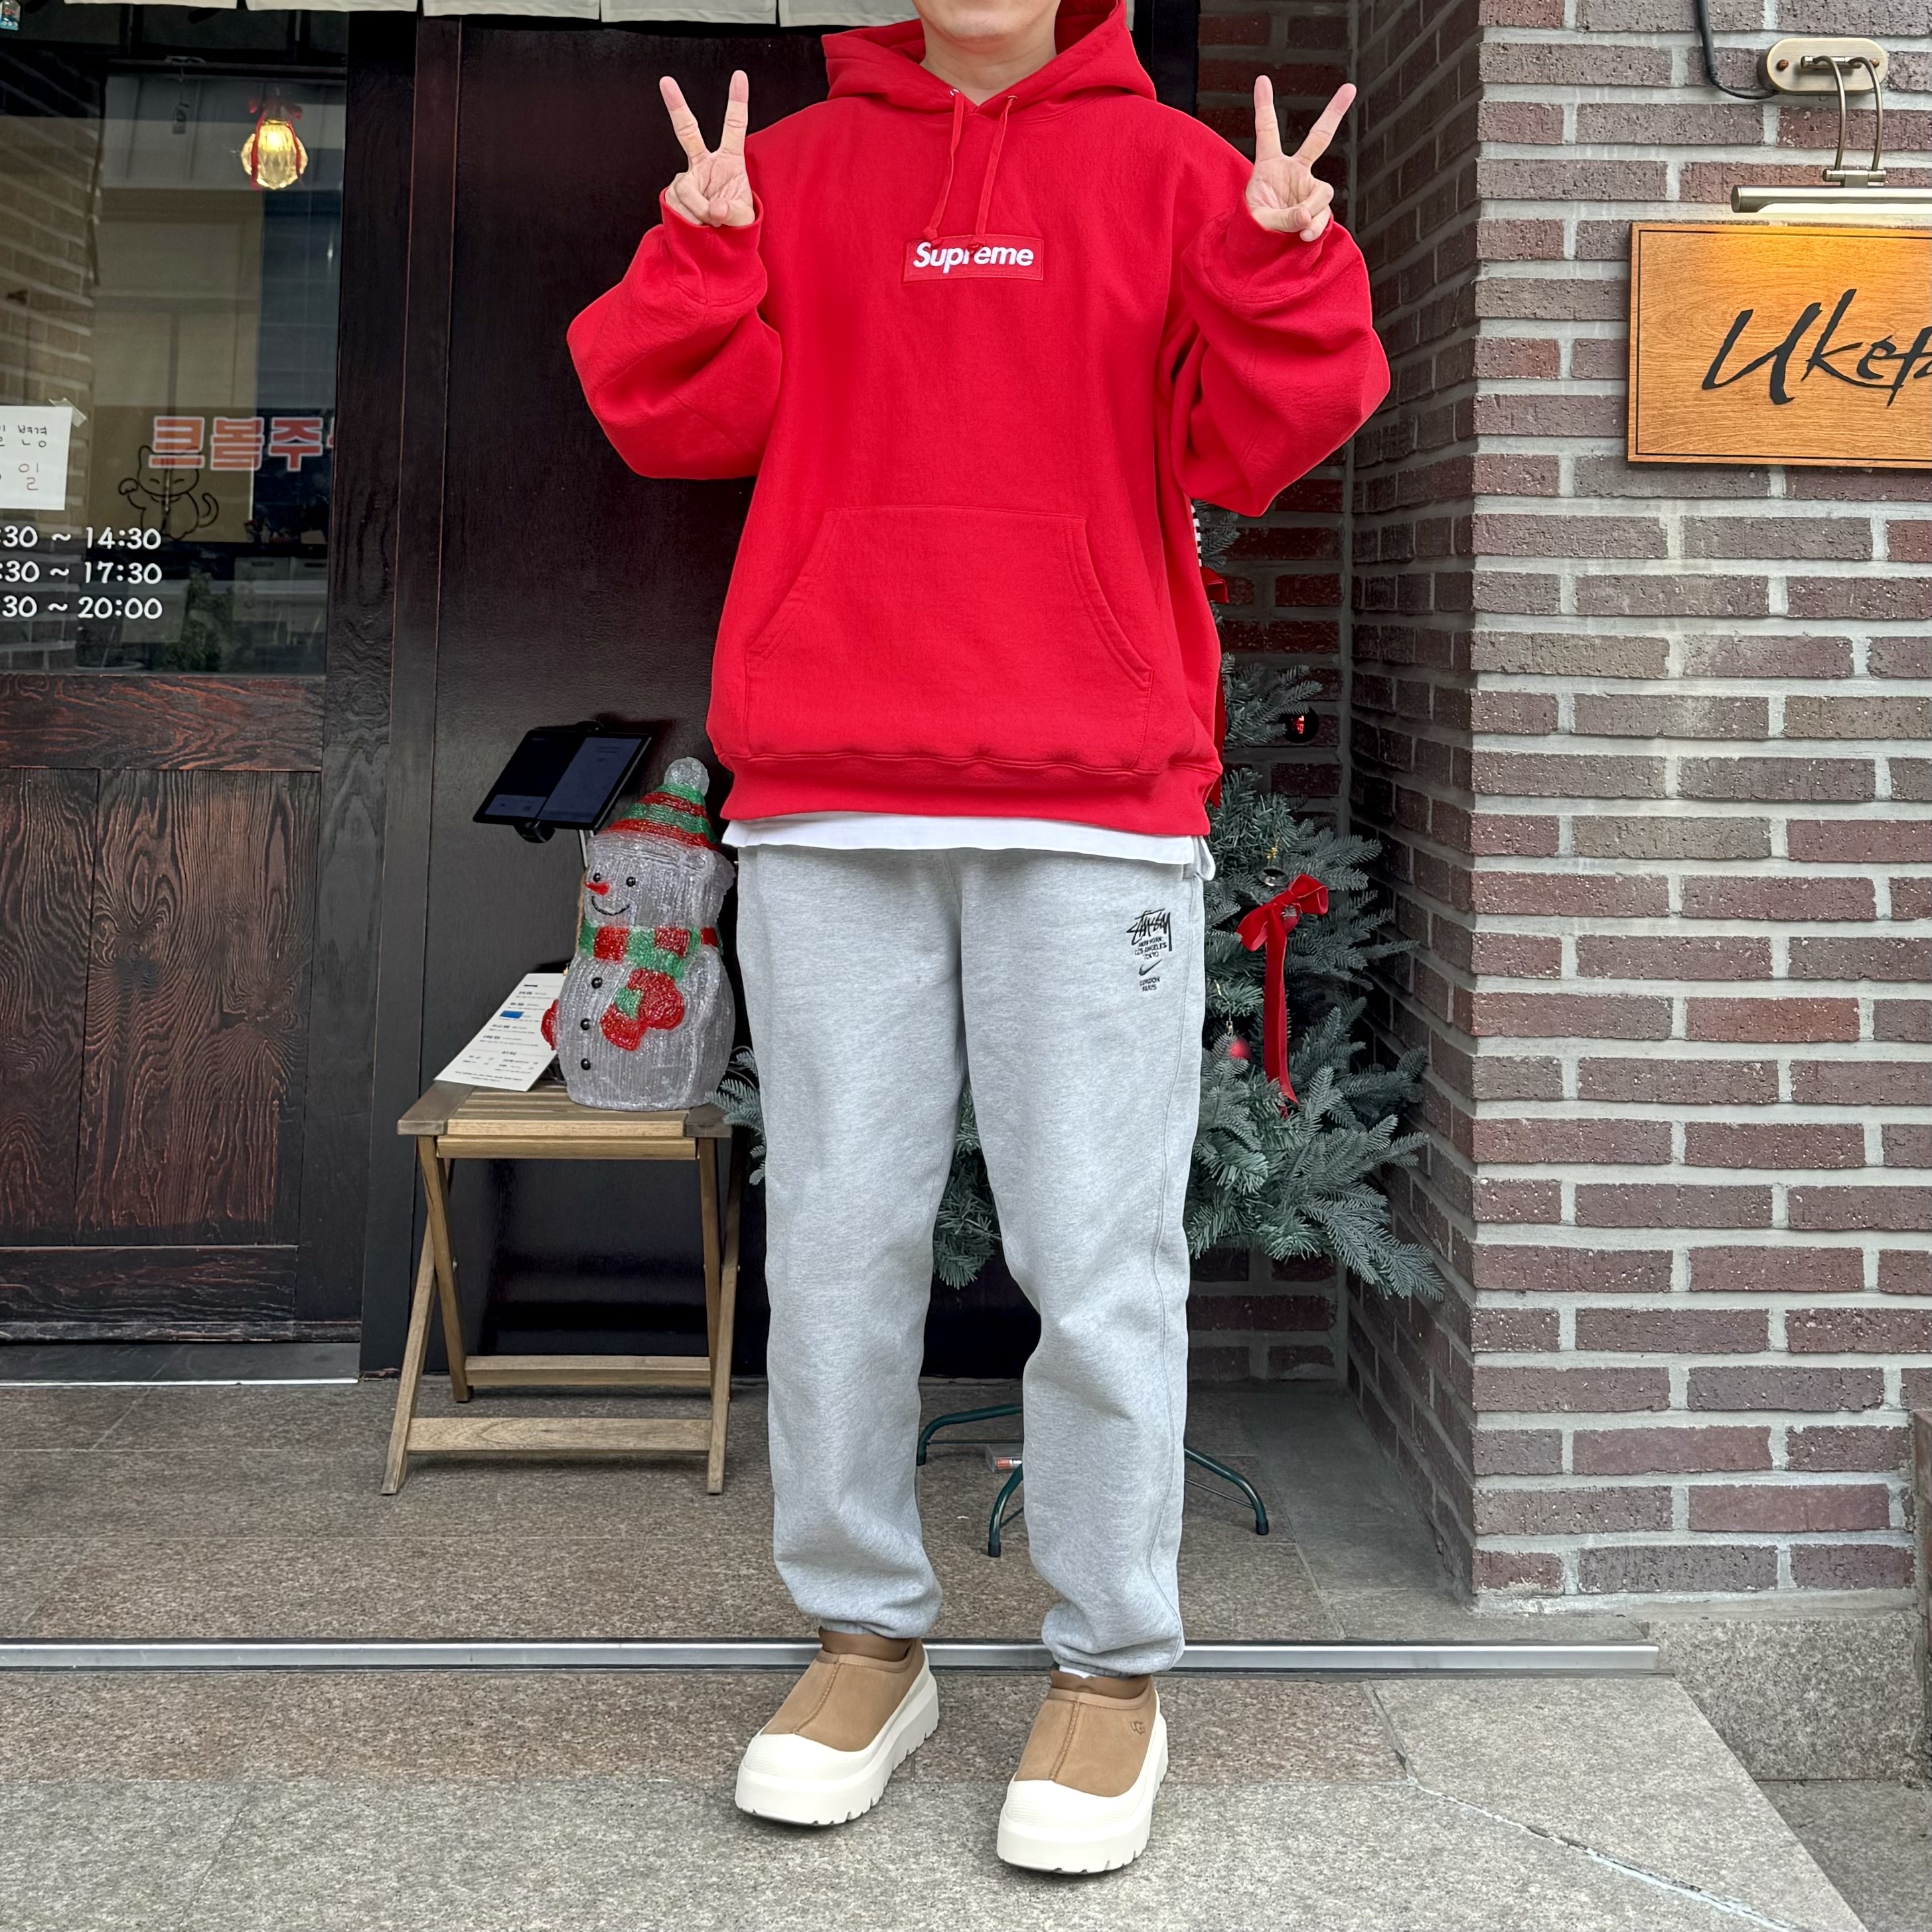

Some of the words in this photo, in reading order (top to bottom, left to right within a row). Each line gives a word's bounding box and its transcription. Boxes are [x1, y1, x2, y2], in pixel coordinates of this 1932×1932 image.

[86, 526, 161, 550] 14:30
[85, 561, 162, 584] 17:30
[78, 597, 163, 619] 20:00
